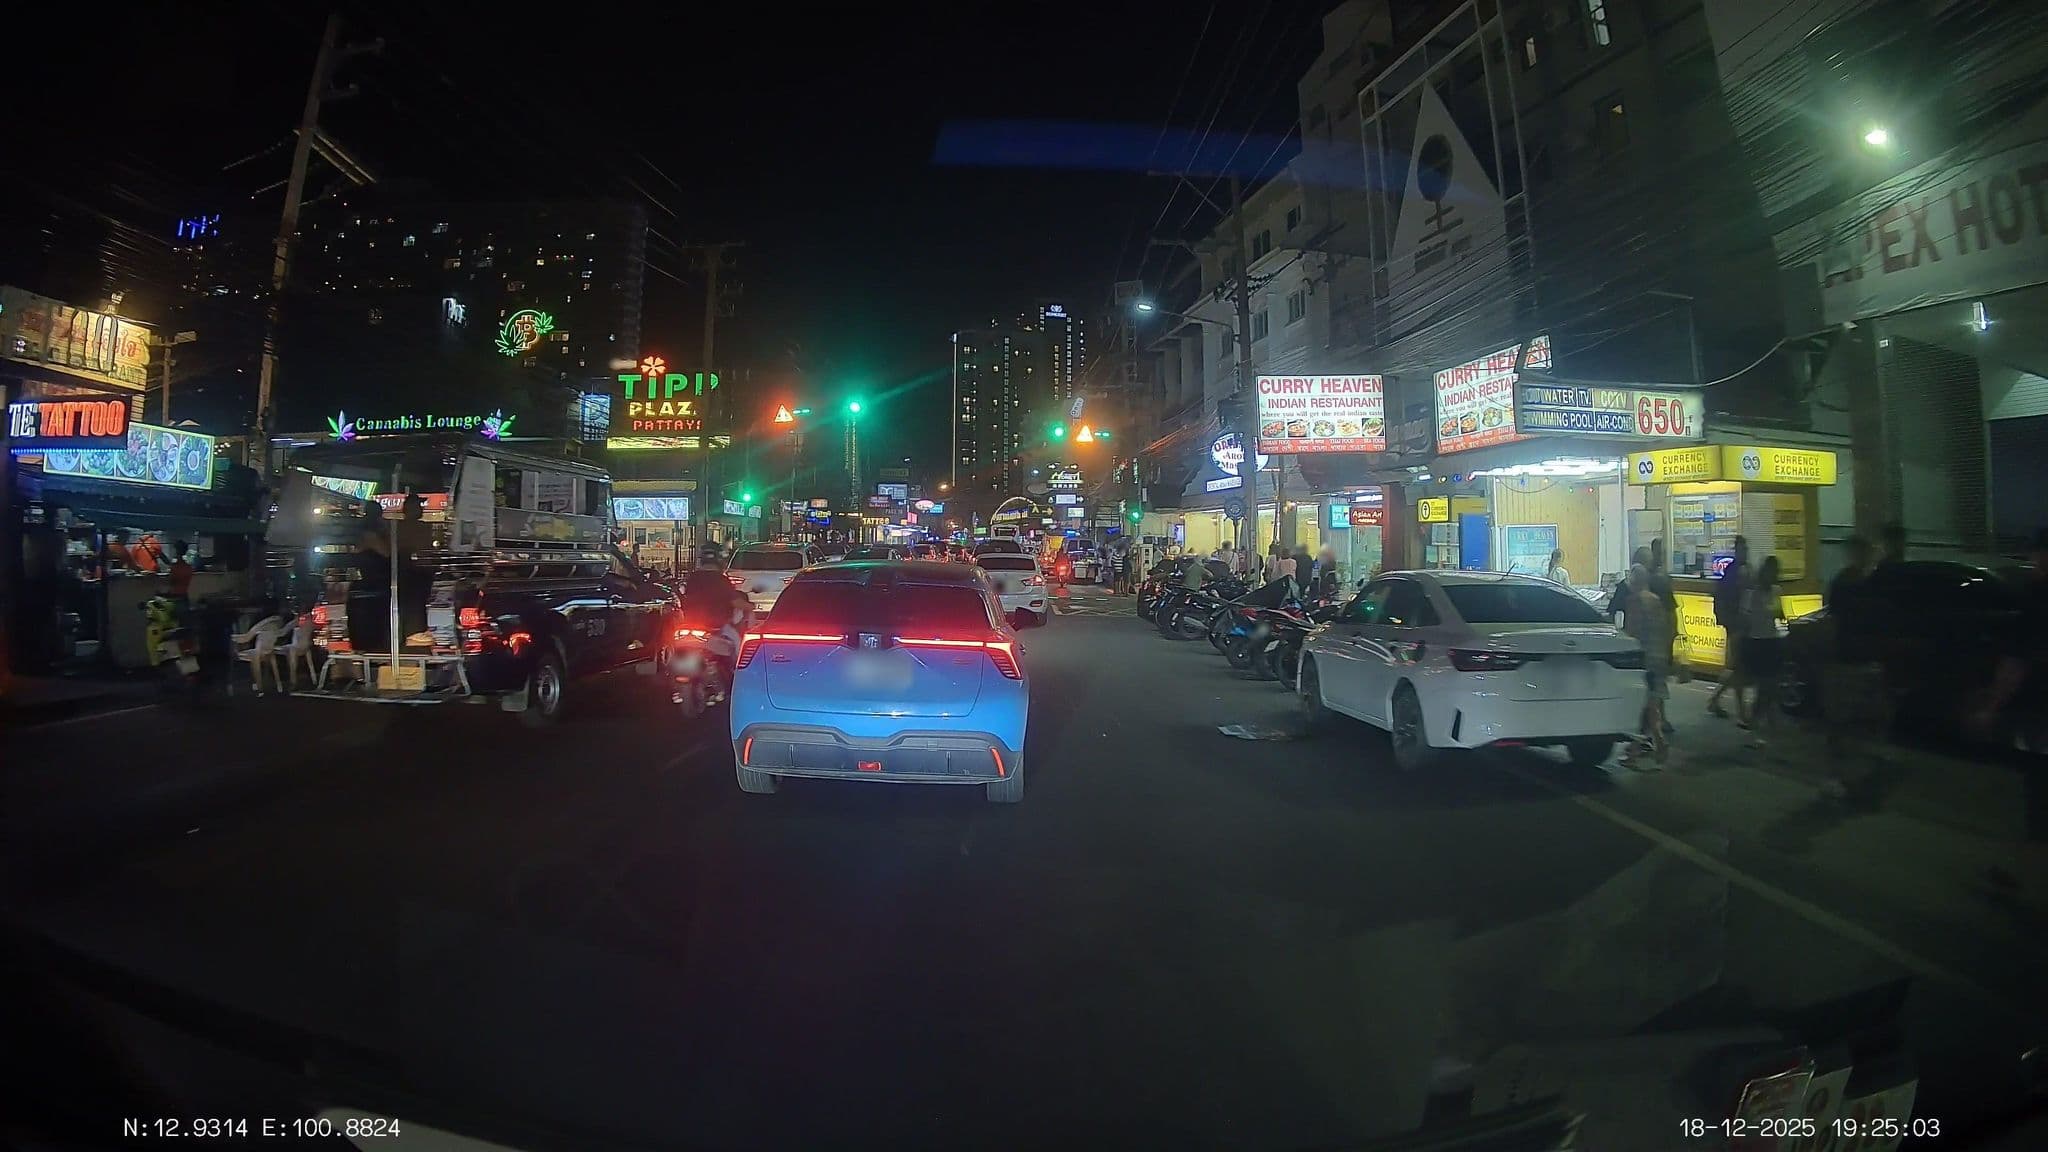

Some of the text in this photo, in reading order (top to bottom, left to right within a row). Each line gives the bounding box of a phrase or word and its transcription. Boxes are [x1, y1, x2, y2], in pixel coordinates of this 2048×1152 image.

[1437, 360, 1481, 391] CURRY
[1260, 378, 1382, 394] CURRY HEAVEN
[1444, 378, 1512, 406] INDIAN RESTA
[1268, 397, 1382, 409] INDIAN RESTAURANT
[1543, 389, 1576, 404] WATER
[1600, 391, 1628, 407] CCTV
[629, 401, 697, 416] PLAZ
[1638, 396, 1685, 435] 650
[39, 400, 126, 437] TATTOO
[355, 414, 482, 431] Cannabis Lounge
[1570, 412, 1593, 428] POOL
[1596, 414, 1634, 431] AIR-COND
[1662, 453, 1707, 465] CURRENCY
[1774, 454, 1819, 466] CURRENCY
[1663, 463, 1708, 475] EXCHANGE
[1775, 465, 1820, 477] EXCHANGE
[1685, 614, 1715, 628] CURREN
[1690, 634, 1725, 648] CHANGE
